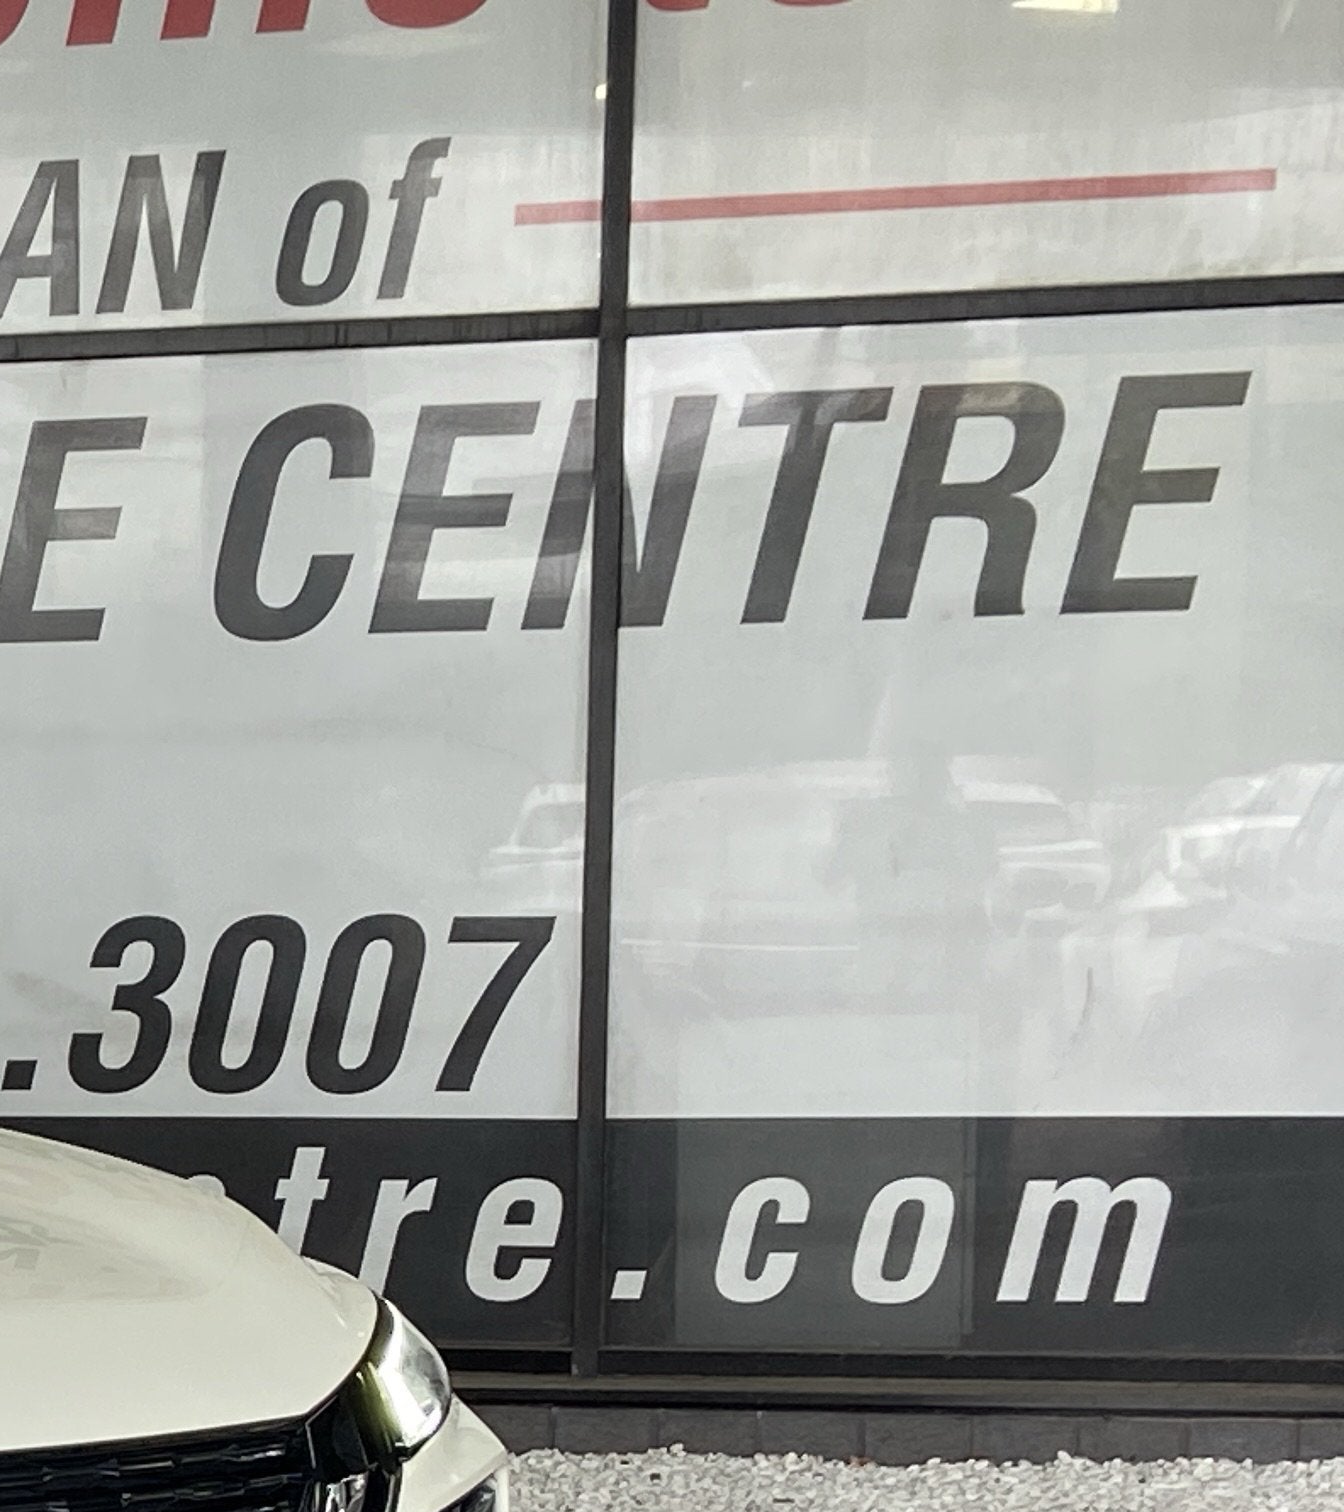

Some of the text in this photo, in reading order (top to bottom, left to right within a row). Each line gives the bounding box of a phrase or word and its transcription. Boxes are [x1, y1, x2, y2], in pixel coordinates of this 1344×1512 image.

[275, 137, 452, 307] of
[212, 370, 1253, 642] CENTRE
[182, 1146, 1173, 1304] tre.com
